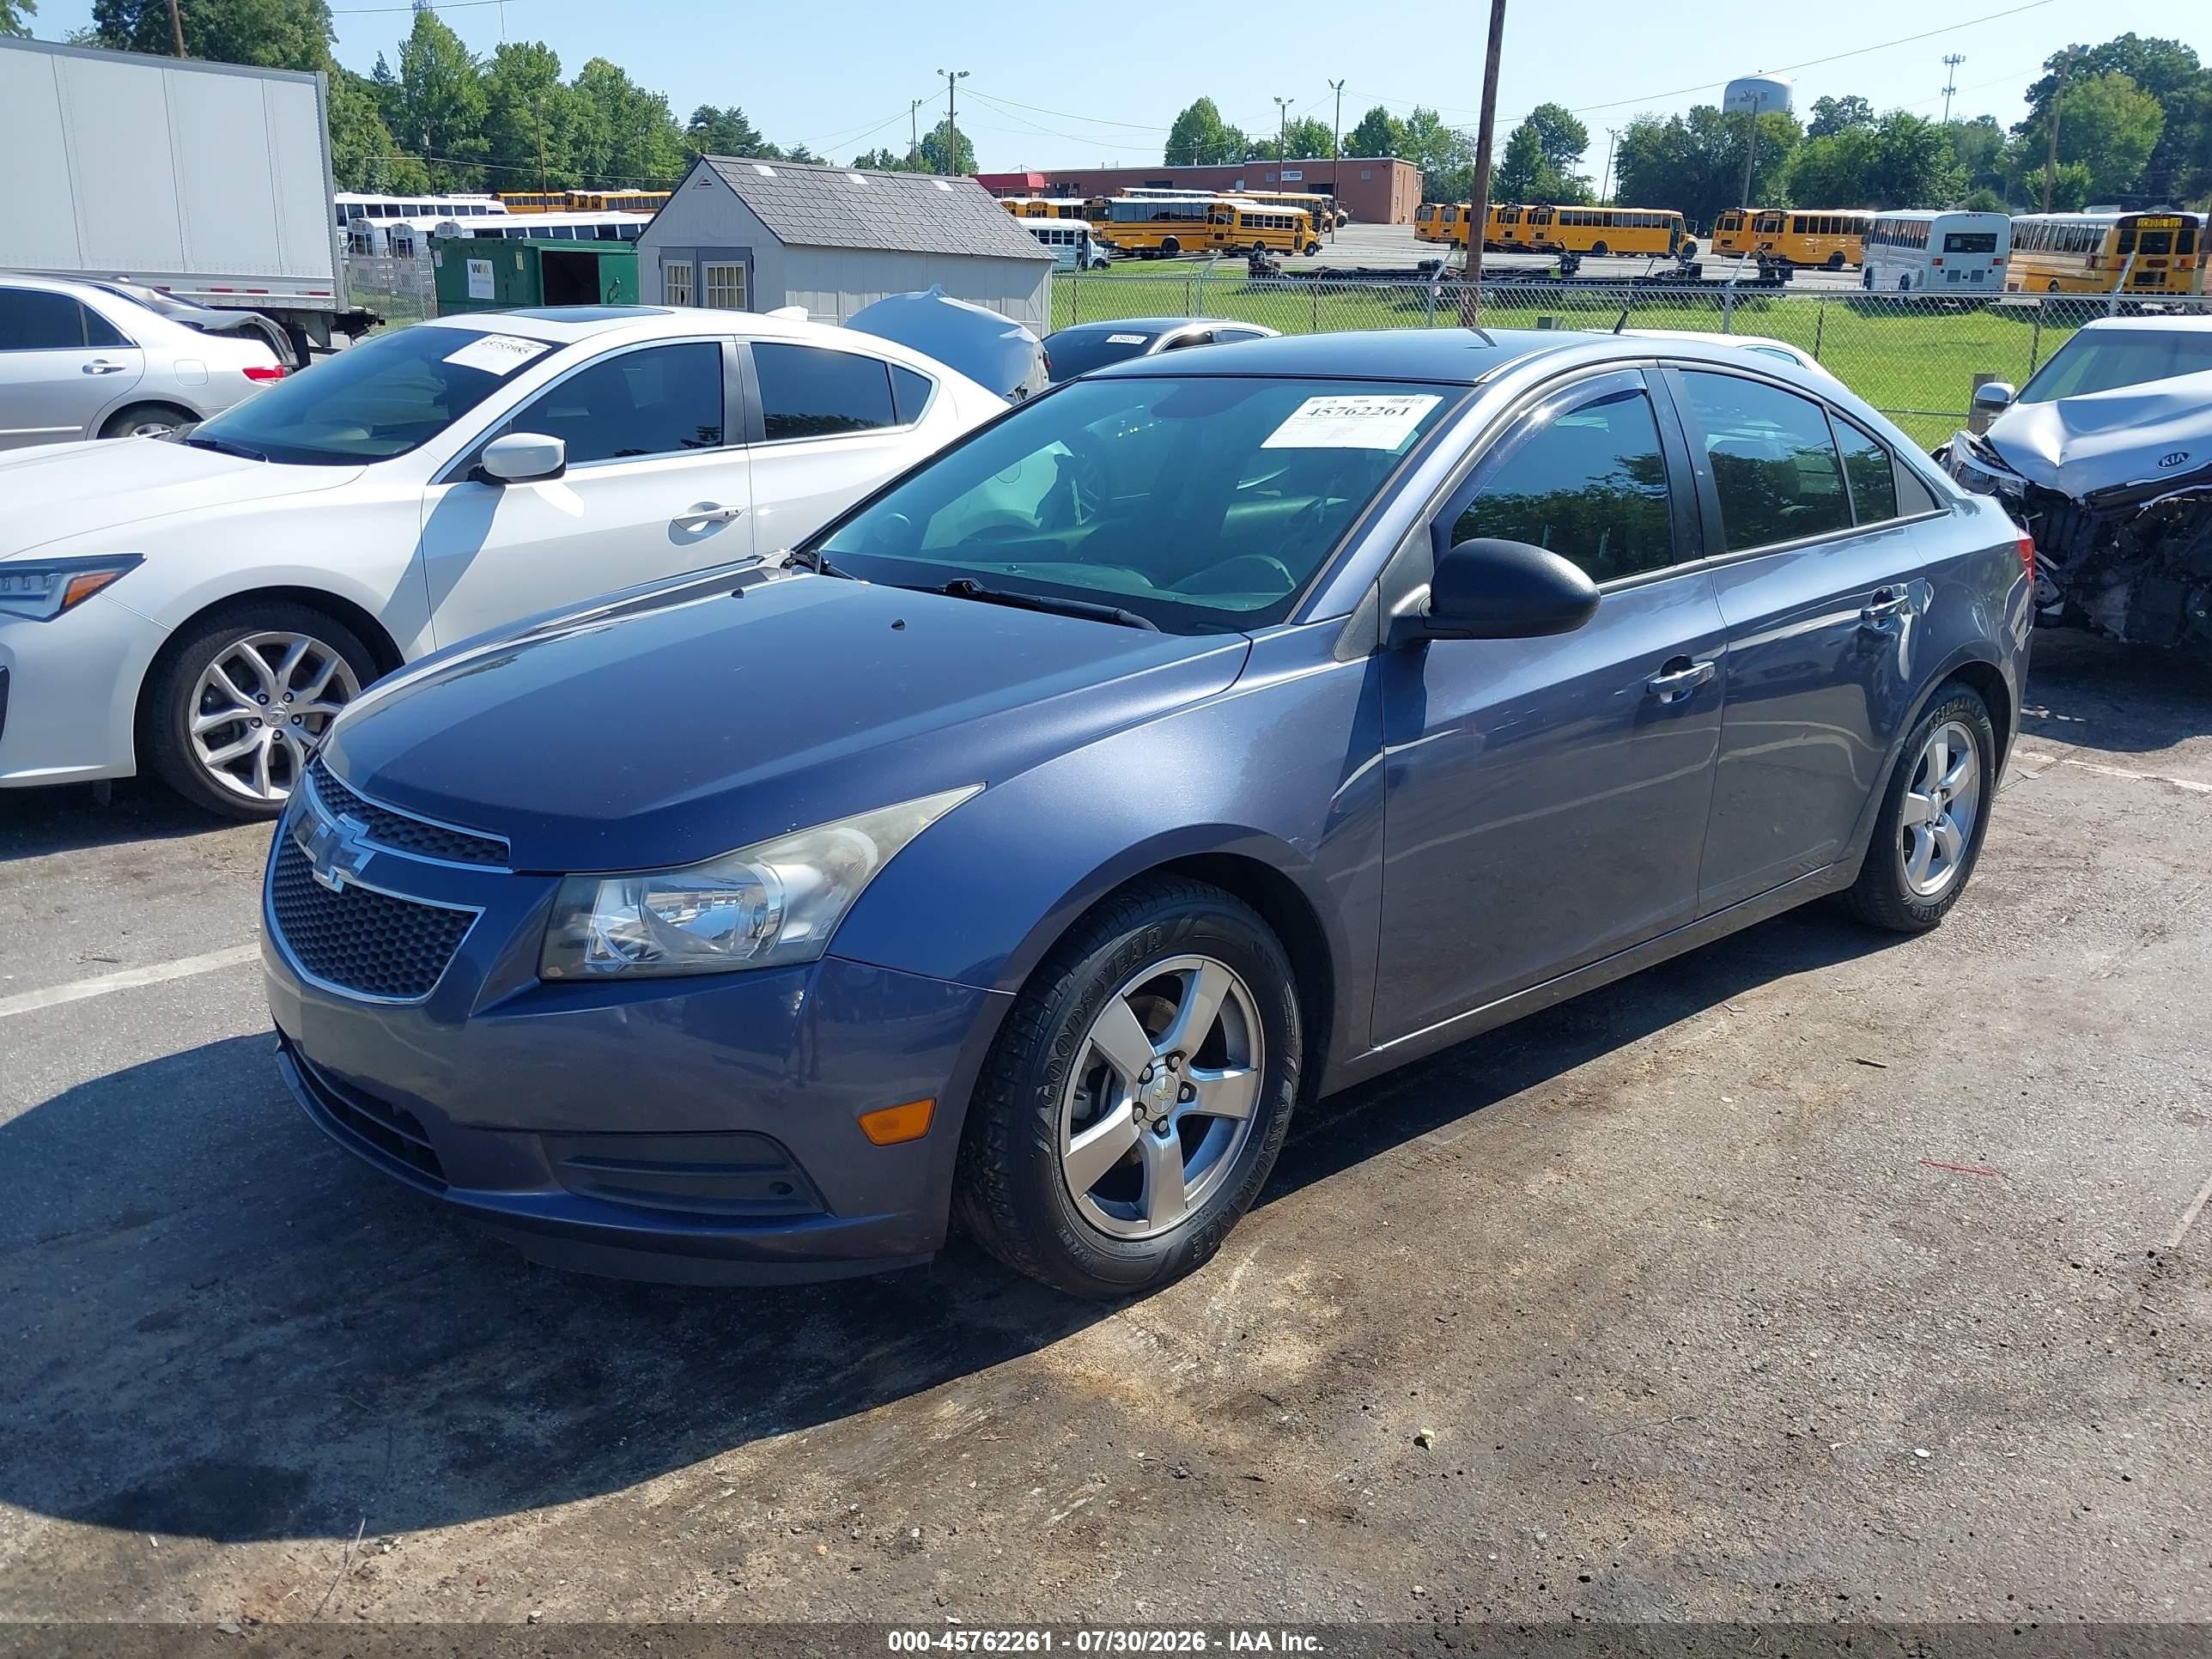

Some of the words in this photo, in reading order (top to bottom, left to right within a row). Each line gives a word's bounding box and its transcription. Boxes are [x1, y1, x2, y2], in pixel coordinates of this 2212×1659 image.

[1306, 406, 1411, 416] 45762261
[2161, 453, 2186, 467] KIA
[1036, 926, 1163, 1109] GOODYEAR
